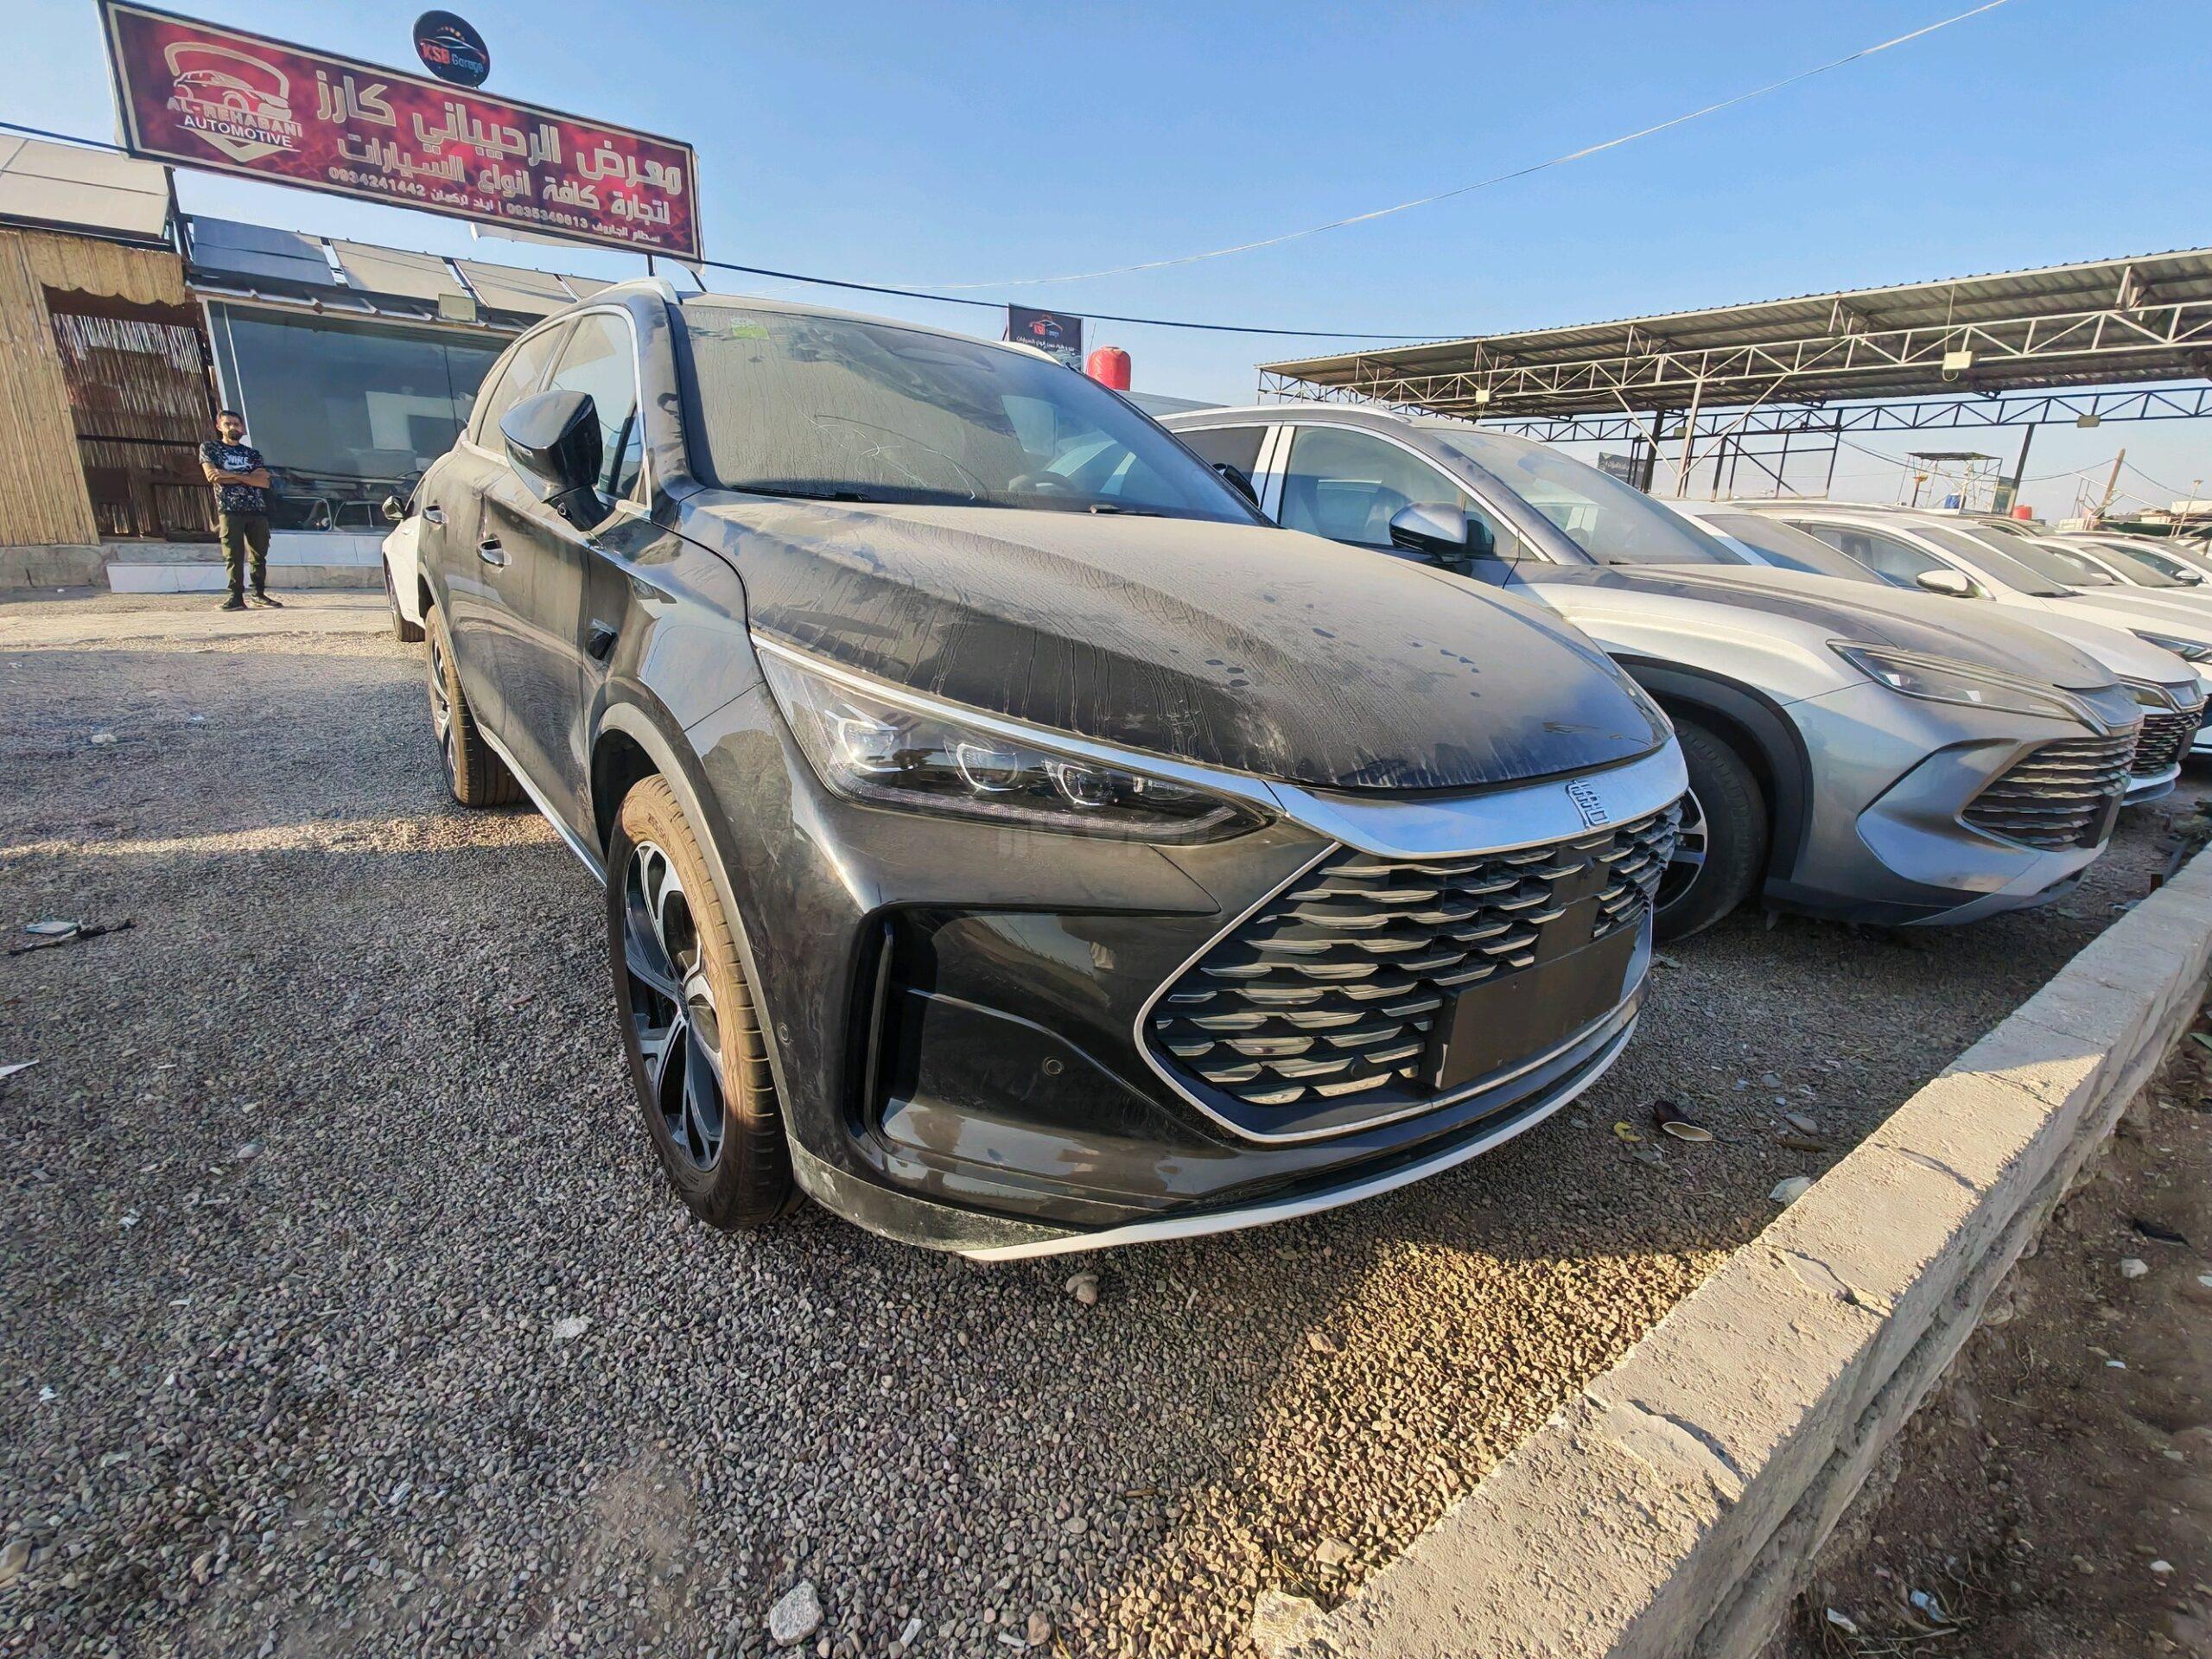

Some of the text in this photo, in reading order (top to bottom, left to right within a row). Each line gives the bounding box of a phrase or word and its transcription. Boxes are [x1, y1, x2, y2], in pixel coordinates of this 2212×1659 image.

[419, 42, 484, 73] KSB Garage
[167, 97, 302, 138] AL-REHABANI
[184, 115, 293, 148] AUTOMOTIVE
[315, 70, 683, 195] معرض الرحيباني كارز
[337, 133, 671, 226] لتجارة كافة انواع السيارات
